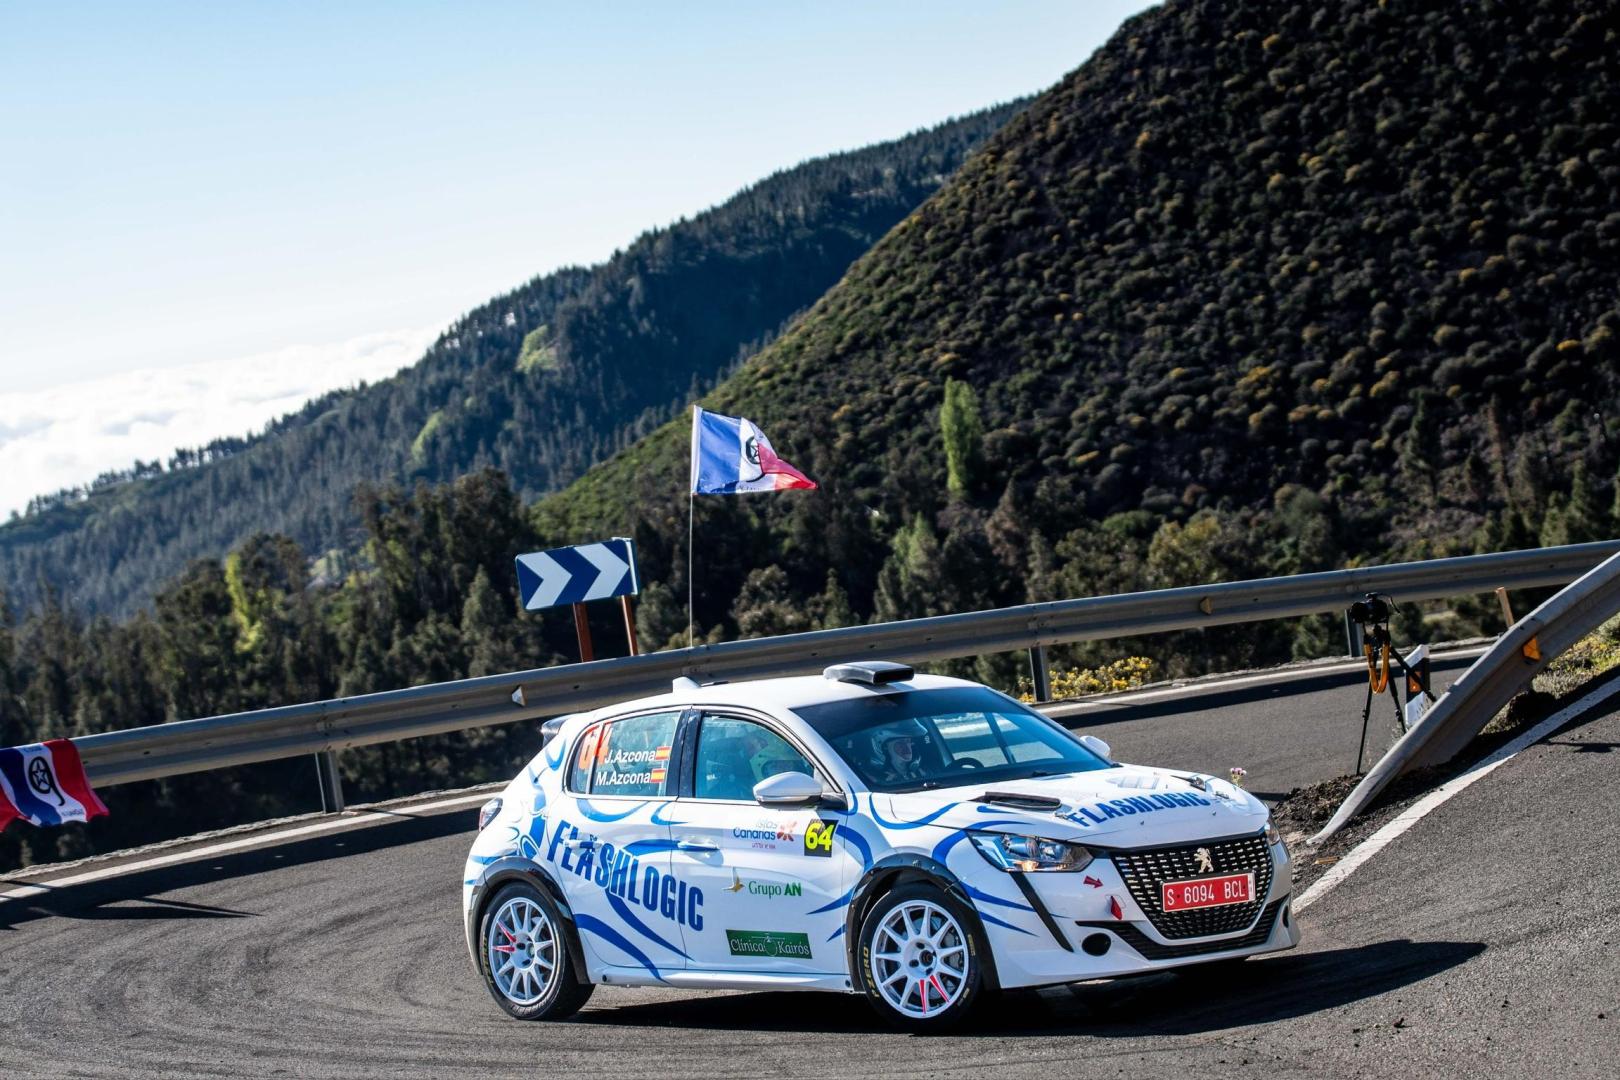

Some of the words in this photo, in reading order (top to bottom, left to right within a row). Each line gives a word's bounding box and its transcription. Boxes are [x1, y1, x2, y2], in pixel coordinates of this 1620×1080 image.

[605, 749, 656, 763] J.Azcona
[596, 770, 651, 786] M.Azcona
[1066, 791, 1212, 827] FLASHLOGIC
[733, 827, 776, 841] Canarias
[805, 822, 835, 851] 64
[547, 820, 704, 932] FLASHLOGIC
[748, 880, 782, 900] Grupo
[784, 882, 802, 897] AN
[1167, 888, 1175, 906] S
[1184, 884, 1215, 904] 6094
[1224, 880, 1246, 899] BCL
[730, 938, 766, 953] Clínica
[776, 940, 811, 956] Kairós
